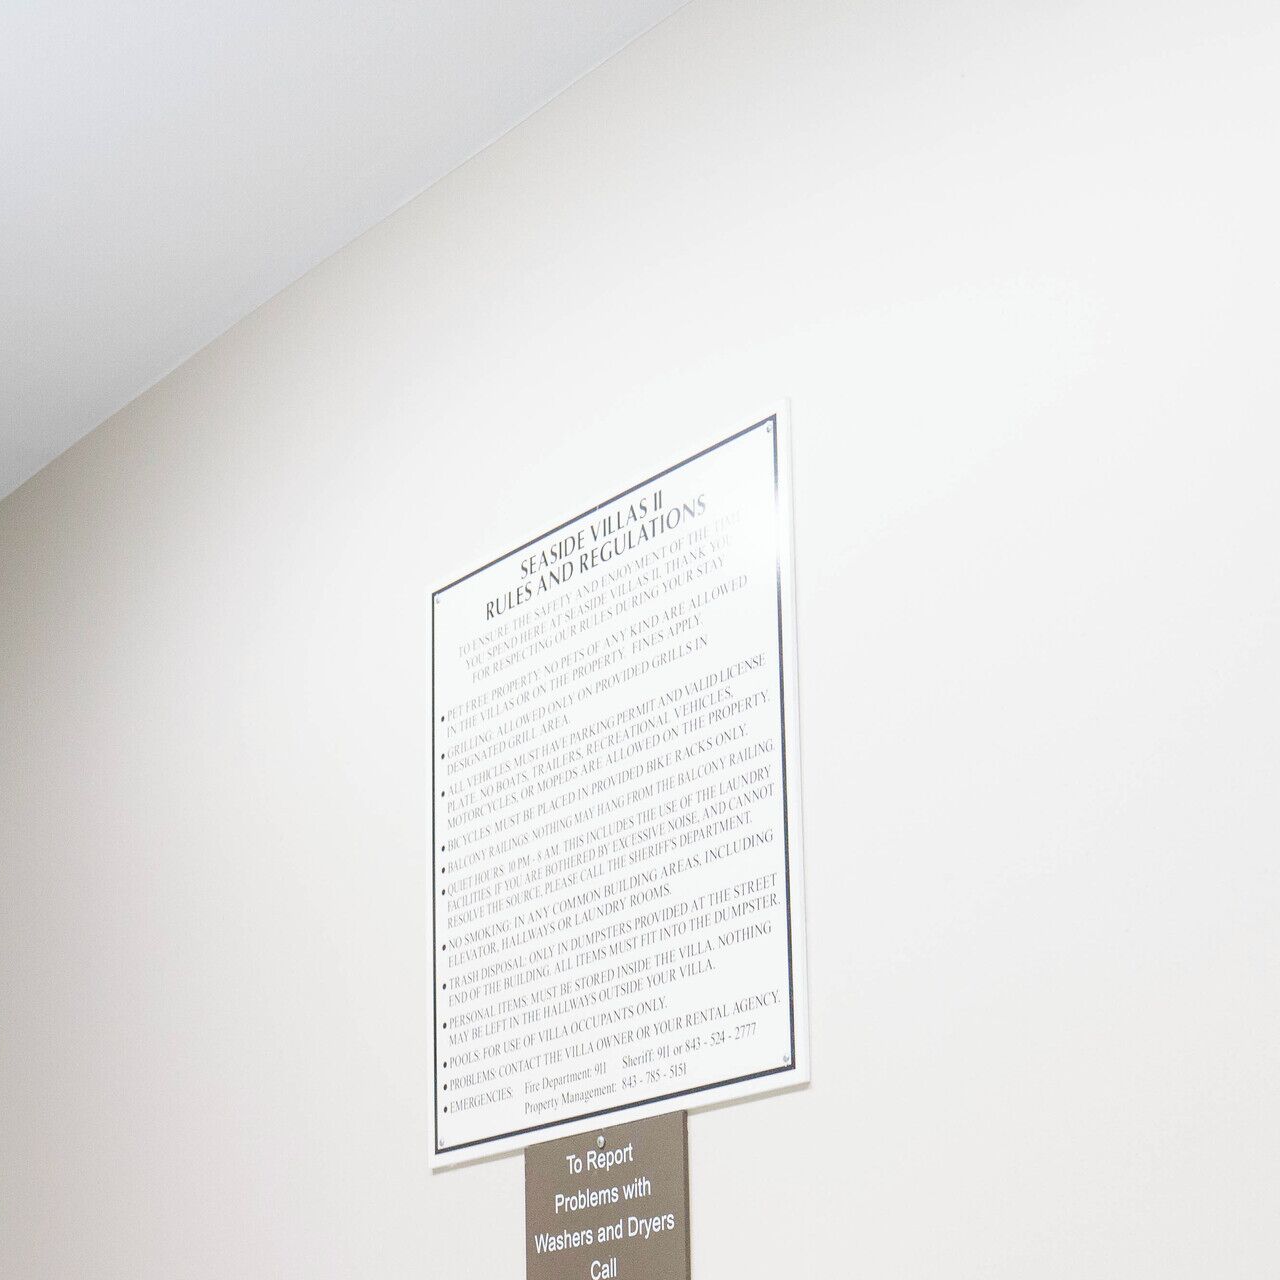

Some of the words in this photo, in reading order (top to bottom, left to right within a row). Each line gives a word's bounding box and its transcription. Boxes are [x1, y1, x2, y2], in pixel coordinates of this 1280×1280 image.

[486, 580, 531, 620] RULES
[537, 559, 573, 595] AND
[579, 492, 706, 574] REGULATIONS
[520, 529, 585, 579] SEASIDE
[590, 496, 647, 544] VILLAS
[654, 489, 662, 511] II
[448, 848, 485, 873] BALCONY
[532, 815, 572, 841] NOTHING
[575, 807, 593, 825] MAY
[597, 795, 624, 817] HANG
[626, 784, 652, 805] FROM
[656, 776, 674, 794] THE
[677, 756, 725, 786] BALCONY
[494, 812, 520, 833] MUST
[523, 806, 534, 822] BE
[537, 790, 575, 816] PLACED
[578, 785, 588, 801] IN
[591, 764, 643, 796] PROVIDED
[646, 753, 671, 774] BIKE
[675, 737, 712, 763] RACKS
[447, 875, 471, 895] QUIET
[508, 859, 515, 873] 10
[517, 854, 529, 870] PM
[564, 834, 583, 853] THIS
[586, 815, 633, 844] INCLUDES
[637, 807, 654, 826] THE
[659, 799, 676, 818] USE
[679, 793, 692, 810] OF
[696, 784, 716, 804] THE
[719, 764, 770, 796] LAUNDRY
[494, 881, 503, 895] IF
[504, 875, 520, 892] YOU
[525, 867, 542, 884] ARE
[545, 848, 595, 877] BOTHERED
[597, 843, 608, 858] BY
[612, 823, 665, 853] EXCESSIVE
[703, 800, 725, 821] AND
[728, 783, 774, 812] CANNOT
[447, 905, 484, 929] RESOLVE
[487, 898, 503, 915] THE
[544, 872, 576, 895] PLEASE
[580, 862, 604, 883] CALL
[608, 855, 625, 873] THE
[448, 935, 461, 950] NO
[514, 914, 523, 928] IN
[529, 905, 550, 923] ANY
[552, 887, 601, 915] COMMON
[604, 868, 656, 898] BUILDING
[705, 828, 773, 864] INCLUDING
[449, 969, 478, 990] TRASH
[529, 945, 553, 964] ONLY
[557, 940, 567, 955] IN
[570, 919, 631, 951] DUMPSTERS
[634, 901, 687, 930] PROVIDED
[692, 895, 705, 912] AT
[707, 887, 729, 907] THE
[733, 872, 776, 898] STREET
[502, 921, 555, 950] HALLWAYS
[558, 915, 572, 931] OR
[575, 897, 625, 925] LAUNDRY
[448, 990, 467, 1007] END
[469, 986, 480, 1000] OF
[483, 979, 501, 996] THE
[554, 957, 572, 974] ALL
[576, 946, 606, 967] ITEMS
[609, 936, 638, 957] MUST
[641, 930, 656, 947] FIT
[659, 921, 686, 941] INTO
[689, 913, 710, 932] THE
[714, 891, 780, 925] DUMPSTER.
[449, 1004, 493, 1029] PERSONAL
[530, 985, 557, 1004] MUST
[560, 981, 571, 996] BE
[574, 968, 614, 991] STORED
[617, 957, 650, 979] INSIDE
[654, 949, 675, 968] THE
[718, 920, 772, 949] NOTHING
[449, 1029, 469, 1046] MAY
[471, 1025, 482, 1039] BE
[485, 1018, 508, 1035] LEFT
[510, 1014, 519, 1028] IN
[523, 1008, 541, 1025] THE
[543, 992, 596, 1019] HALLWAYS
[598, 978, 642, 1003] OUTSIDE
[646, 968, 675, 989] YOUR
[483, 1042, 502, 1059] FOR
[504, 1037, 520, 1053] USE
[523, 1033, 534, 1047] OF
[538, 1023, 567, 1043] VILLA
[570, 1005, 633, 1034] OCCUPANTS
[636, 995, 667, 1016] ONLY.
[498, 1054, 541, 1077] CONTACT
[543, 1049, 562, 1065] THE
[565, 1040, 593, 1060] VILLA
[596, 1030, 633, 1051] OWNER
[636, 1025, 651, 1041] OR
[653, 1016, 682, 1036] YOUR
[685, 1004, 729, 1028] RENTAL
[732, 990, 780, 1015] AGENCY.
[524, 1078, 539, 1094] Fire
[542, 1065, 591, 1092] Department:
[594, 1061, 606, 1076] 911
[622, 1048, 654, 1069] Sheriff:
[657, 1044, 669, 1060] 911
[673, 1045, 682, 1056] or
[684, 1036, 700, 1053] 843
[710, 1030, 724, 1046] 524
[734, 1021, 756, 1040] 2777
[524, 1094, 557, 1116] Property
[561, 1080, 616, 1108] Management:
[622, 1075, 636, 1090] 843
[645, 1069, 659, 1084] 785
[669, 1062, 686, 1079] 5151
[555, 1188, 619, 1214] Problems
[623, 1176, 651, 1197] with
[566, 1153, 583, 1175] To
[587, 1142, 633, 1171] Report
[535, 1225, 593, 1254] Washers
[598, 1220, 622, 1240] and
[628, 1212, 675, 1239] Dryers
[590, 1257, 617, 1280] Call
